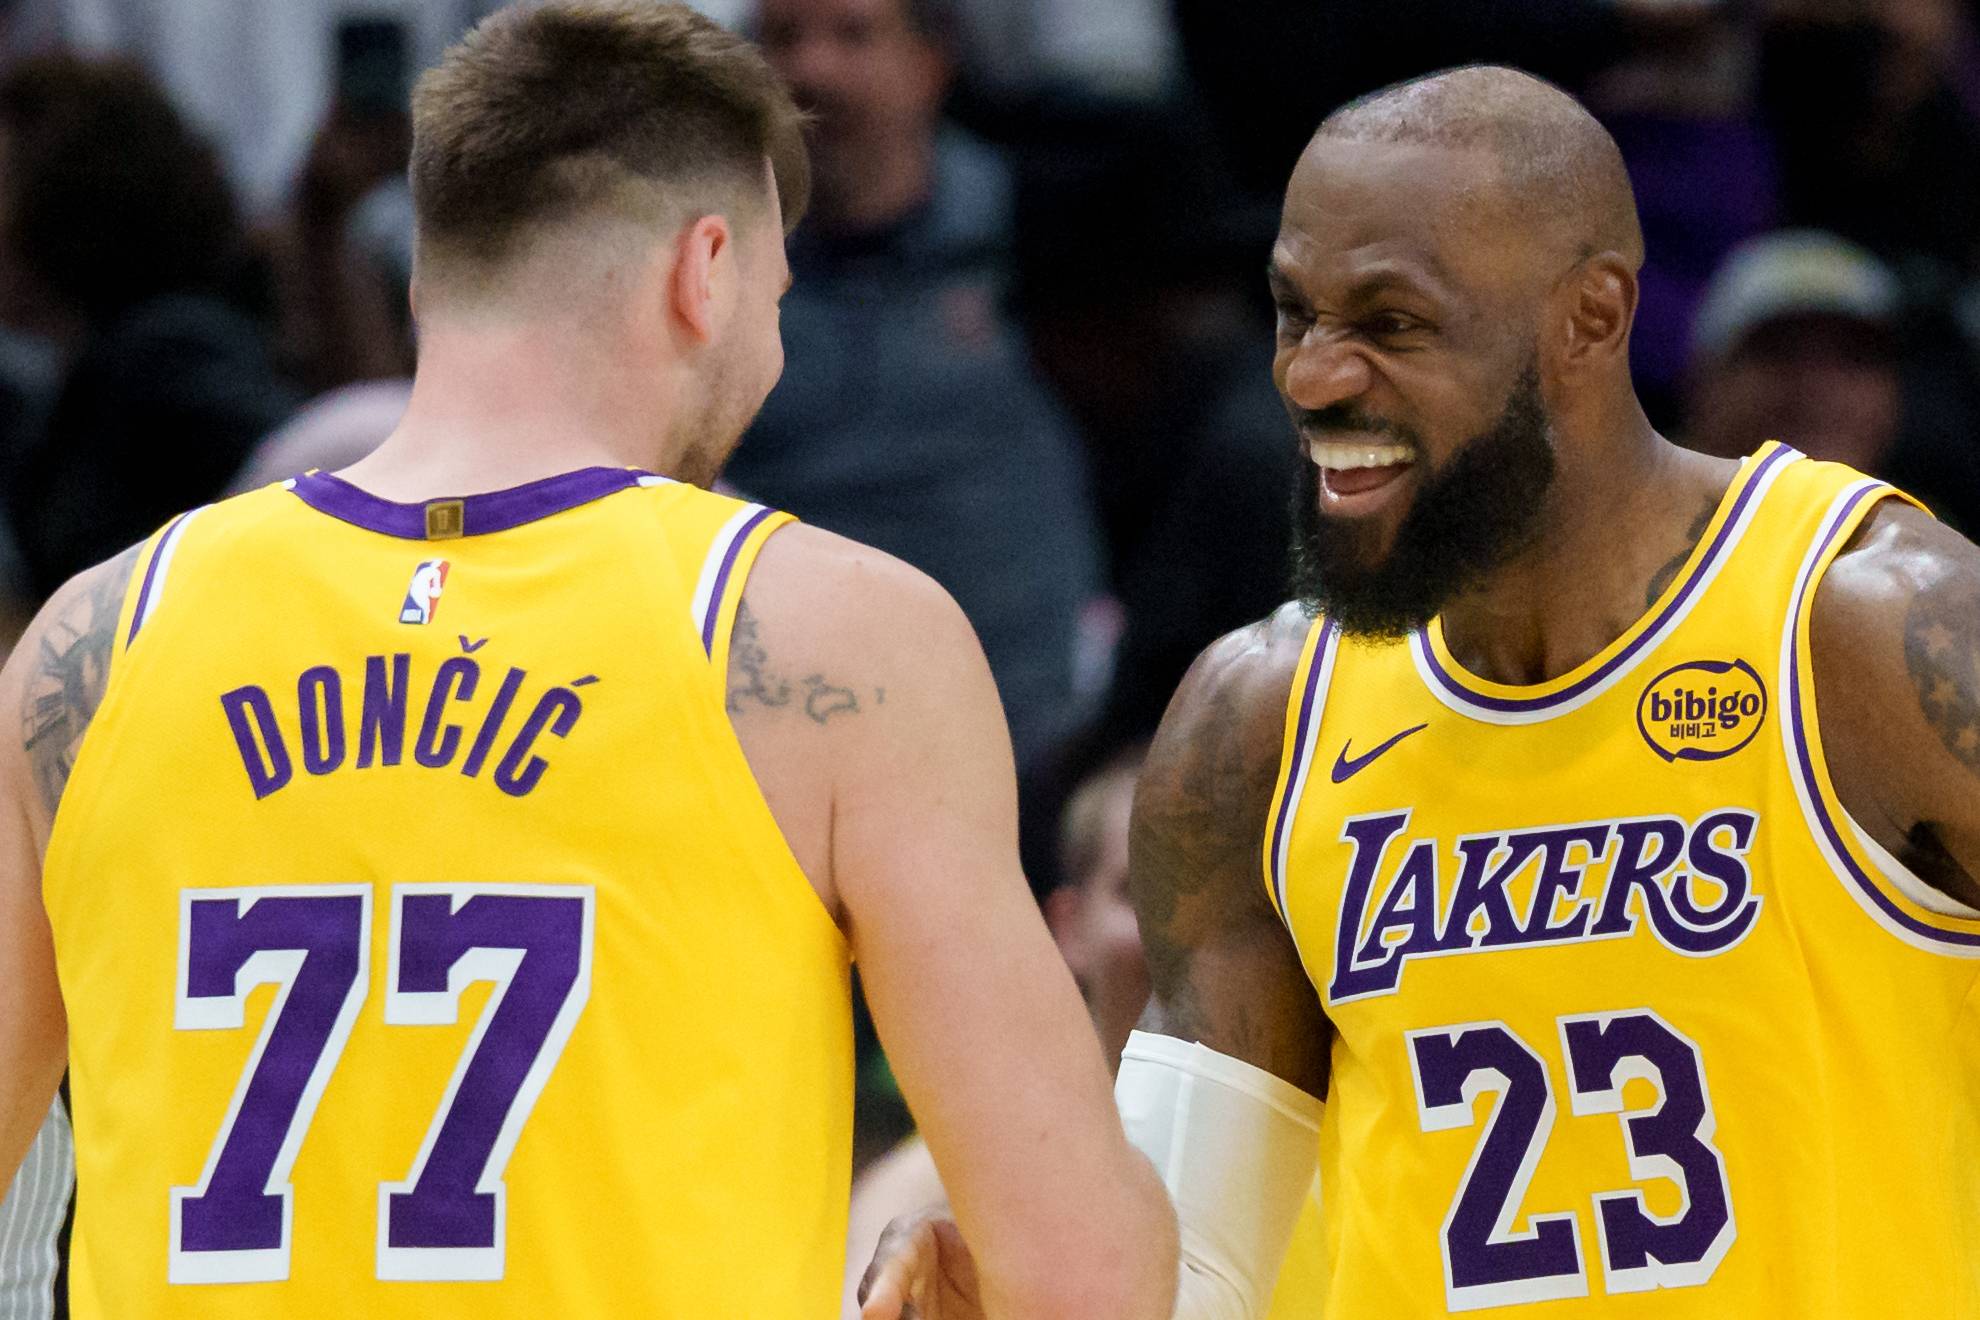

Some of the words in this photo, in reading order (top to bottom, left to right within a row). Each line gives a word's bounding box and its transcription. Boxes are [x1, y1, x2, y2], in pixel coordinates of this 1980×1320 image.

[219, 634, 601, 801] DONČIĆ
[1651, 686, 1760, 729] bibigo
[1670, 722, 1716, 739] 비비고
[1328, 806, 1762, 1006] LAKERS
[169, 883, 595, 1284] 77
[1404, 1007, 1737, 1313] 23
